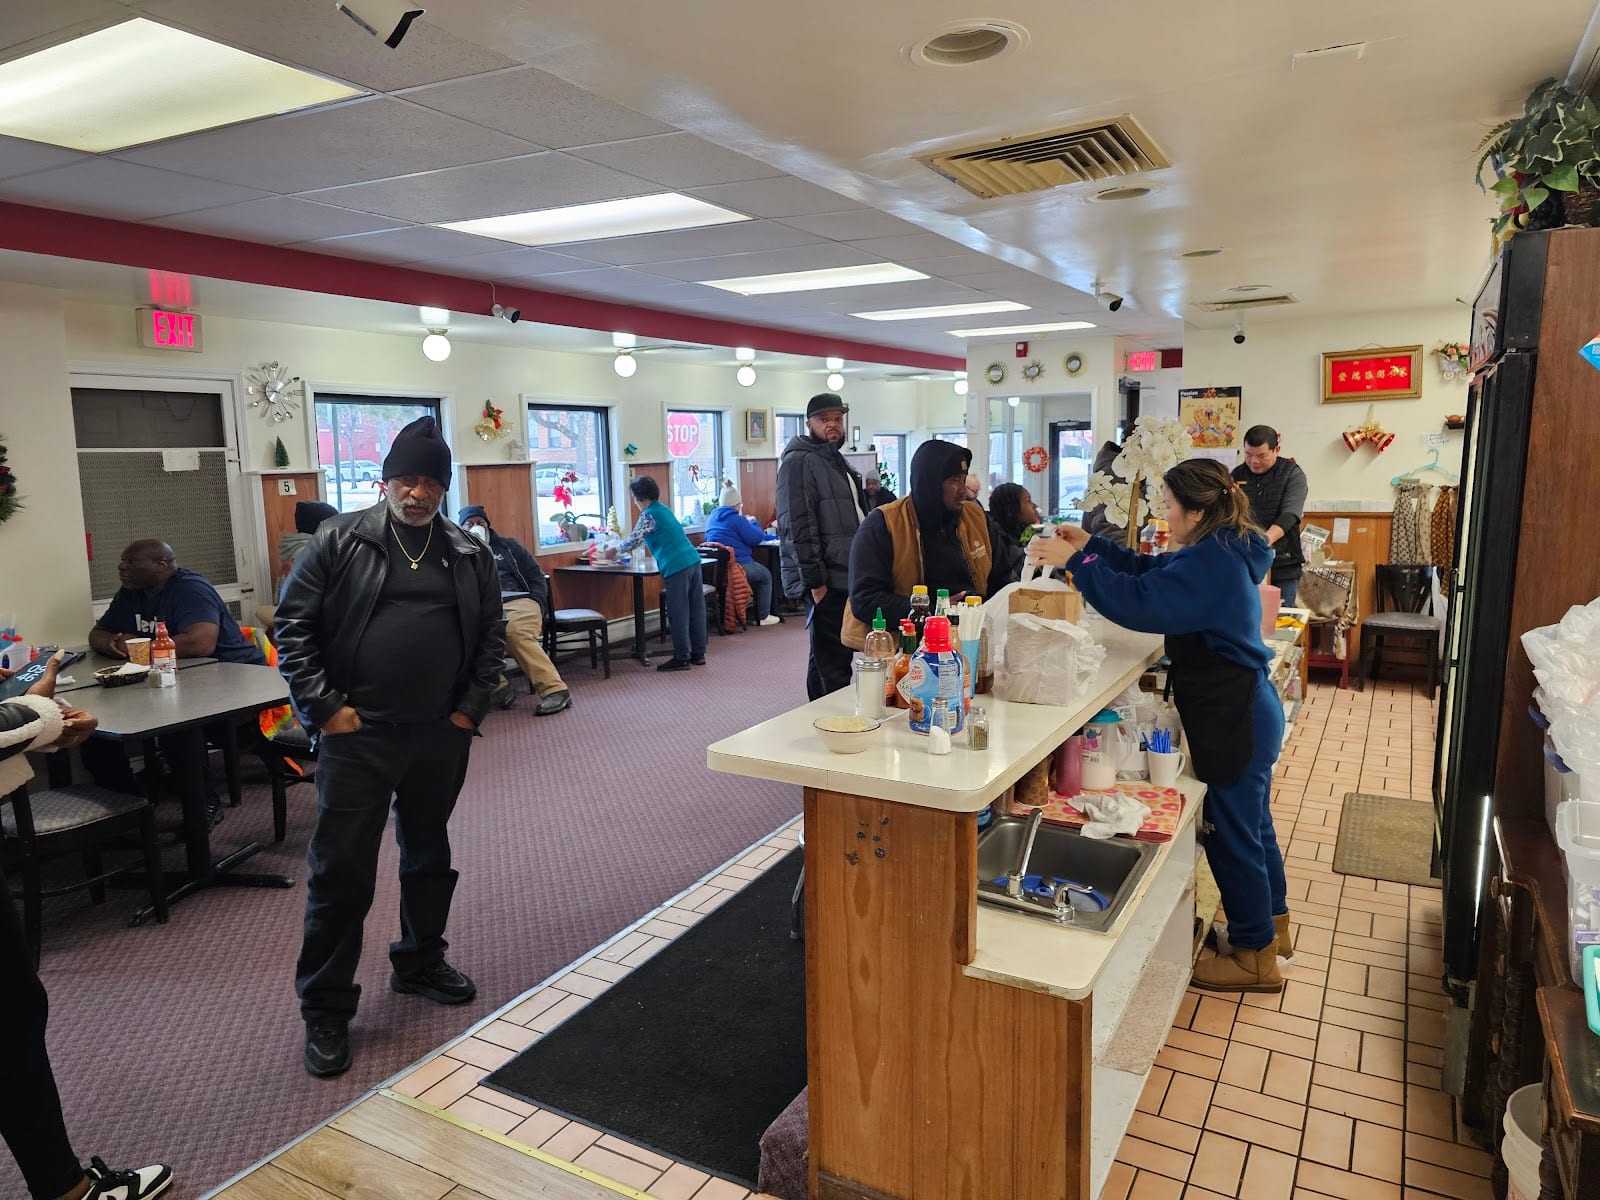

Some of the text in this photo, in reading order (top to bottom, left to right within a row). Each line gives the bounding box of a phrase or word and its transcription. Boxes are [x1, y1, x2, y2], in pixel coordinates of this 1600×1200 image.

[153, 311, 195, 348] EXIT
[667, 424, 698, 442] STOP
[283, 480, 291, 493] 5
[16, 672, 40, 682] 46
